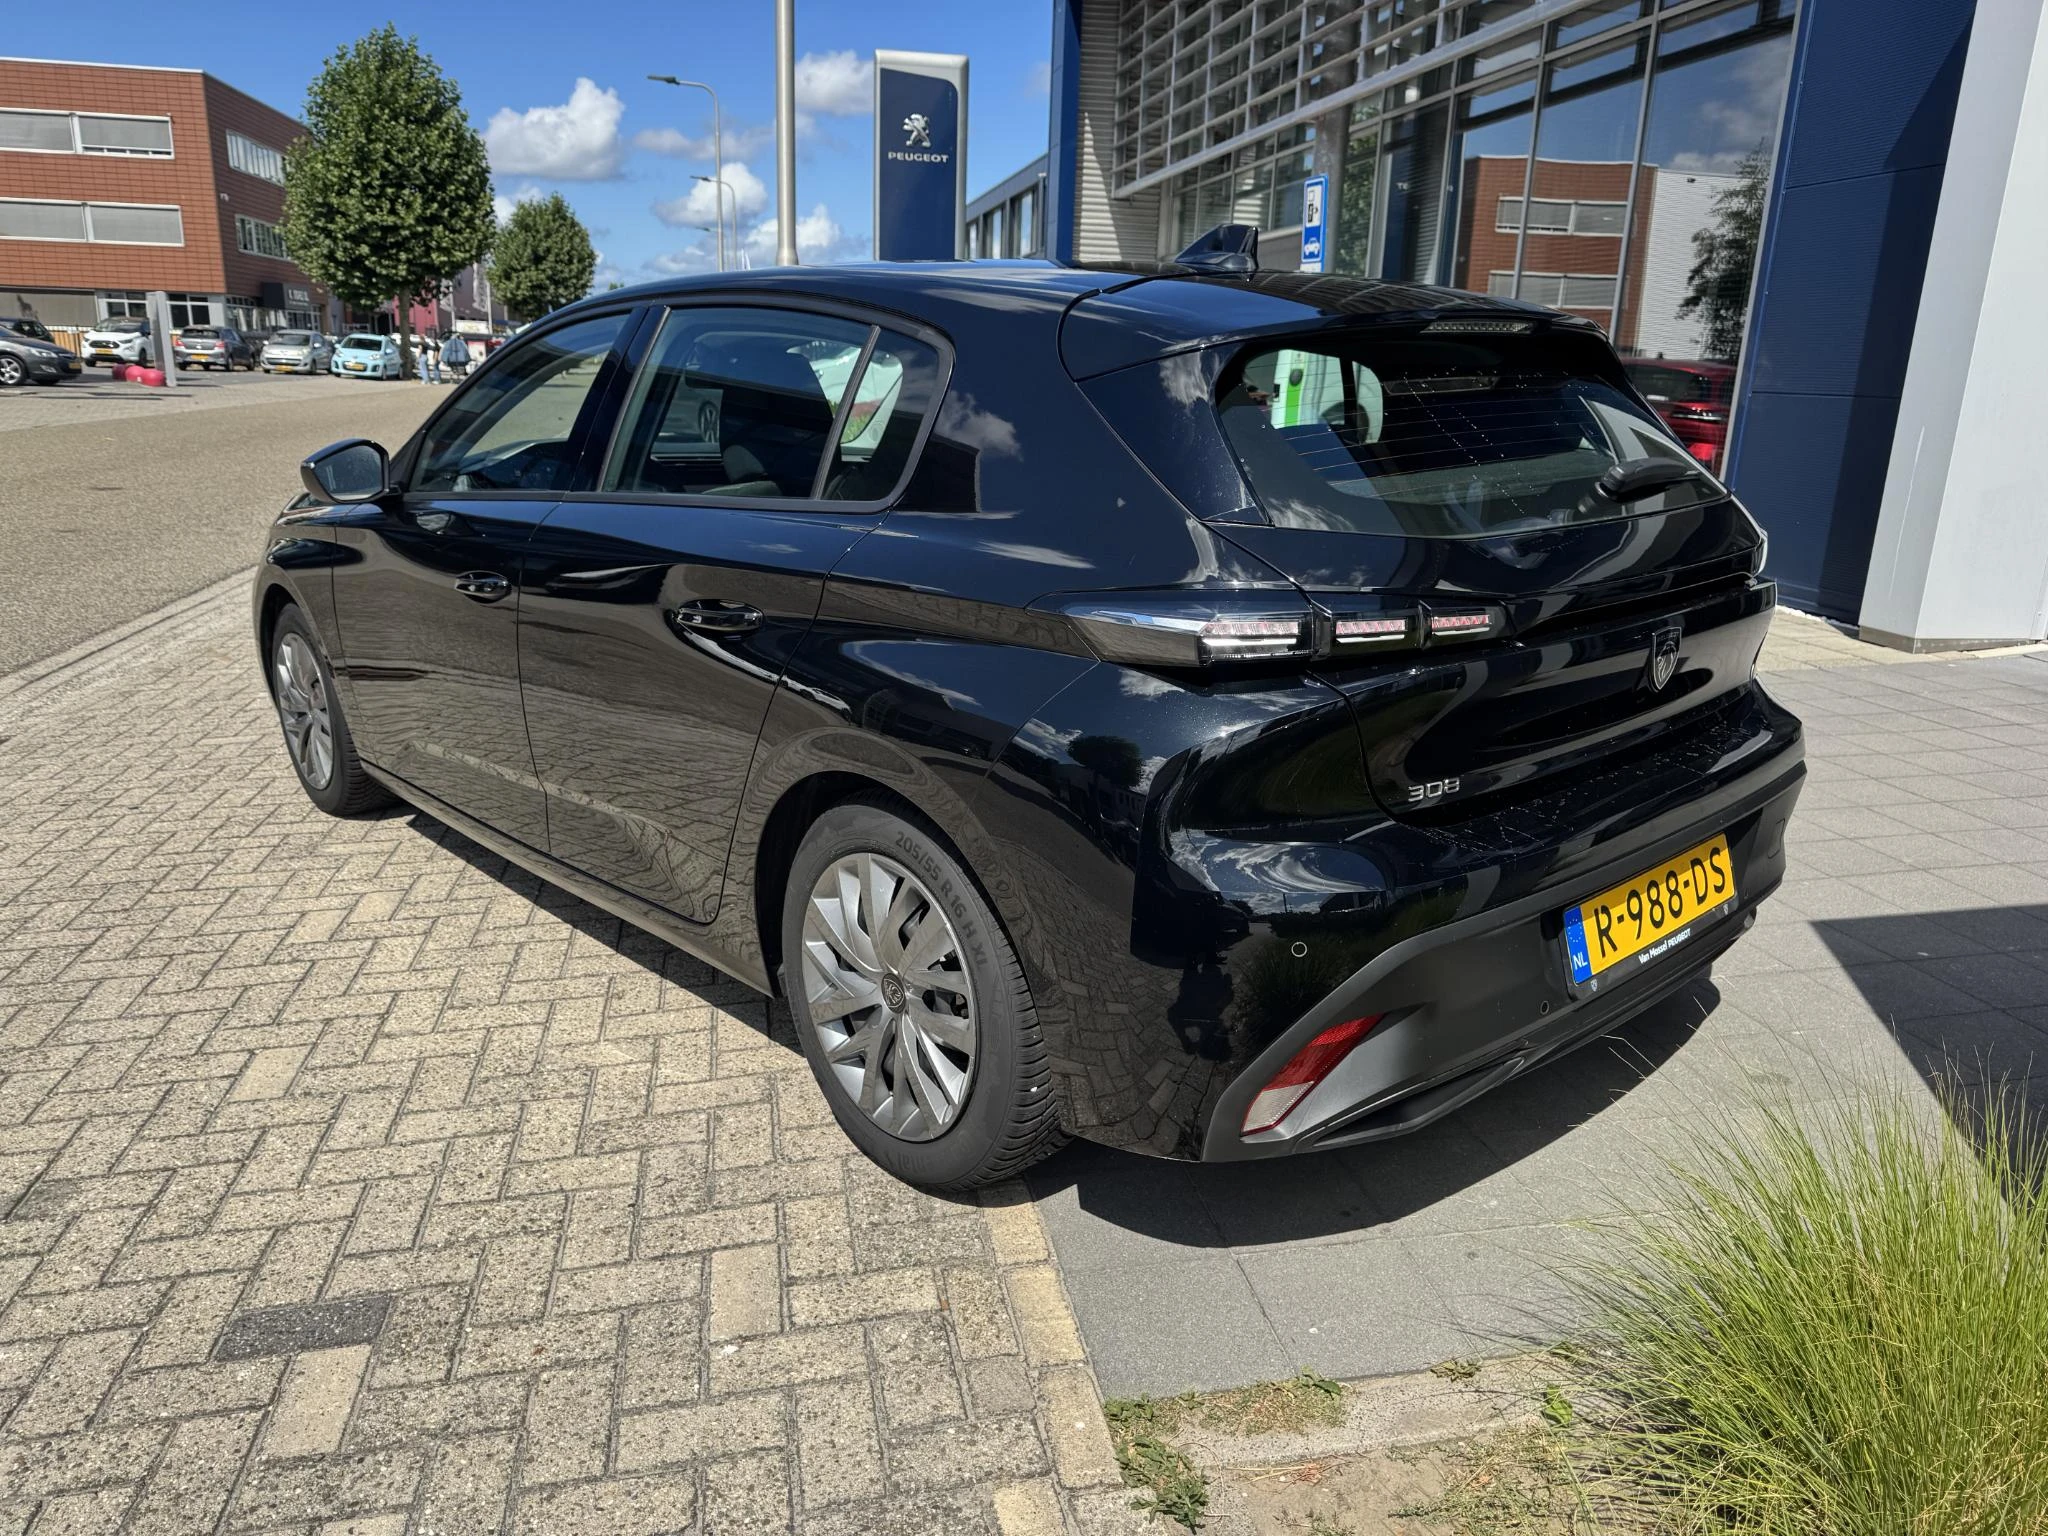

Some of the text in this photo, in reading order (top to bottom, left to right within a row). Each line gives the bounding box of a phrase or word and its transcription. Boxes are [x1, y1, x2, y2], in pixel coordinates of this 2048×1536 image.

[888, 151, 949, 163] PEUGEOT
[1408, 777, 1460, 802] 308
[895, 831, 942, 881] 205/55
[1593, 847, 1726, 958] R-988-DS
[1572, 952, 1588, 970] NL
[1638, 928, 1691, 964] Van Mossel PEUGEOT
